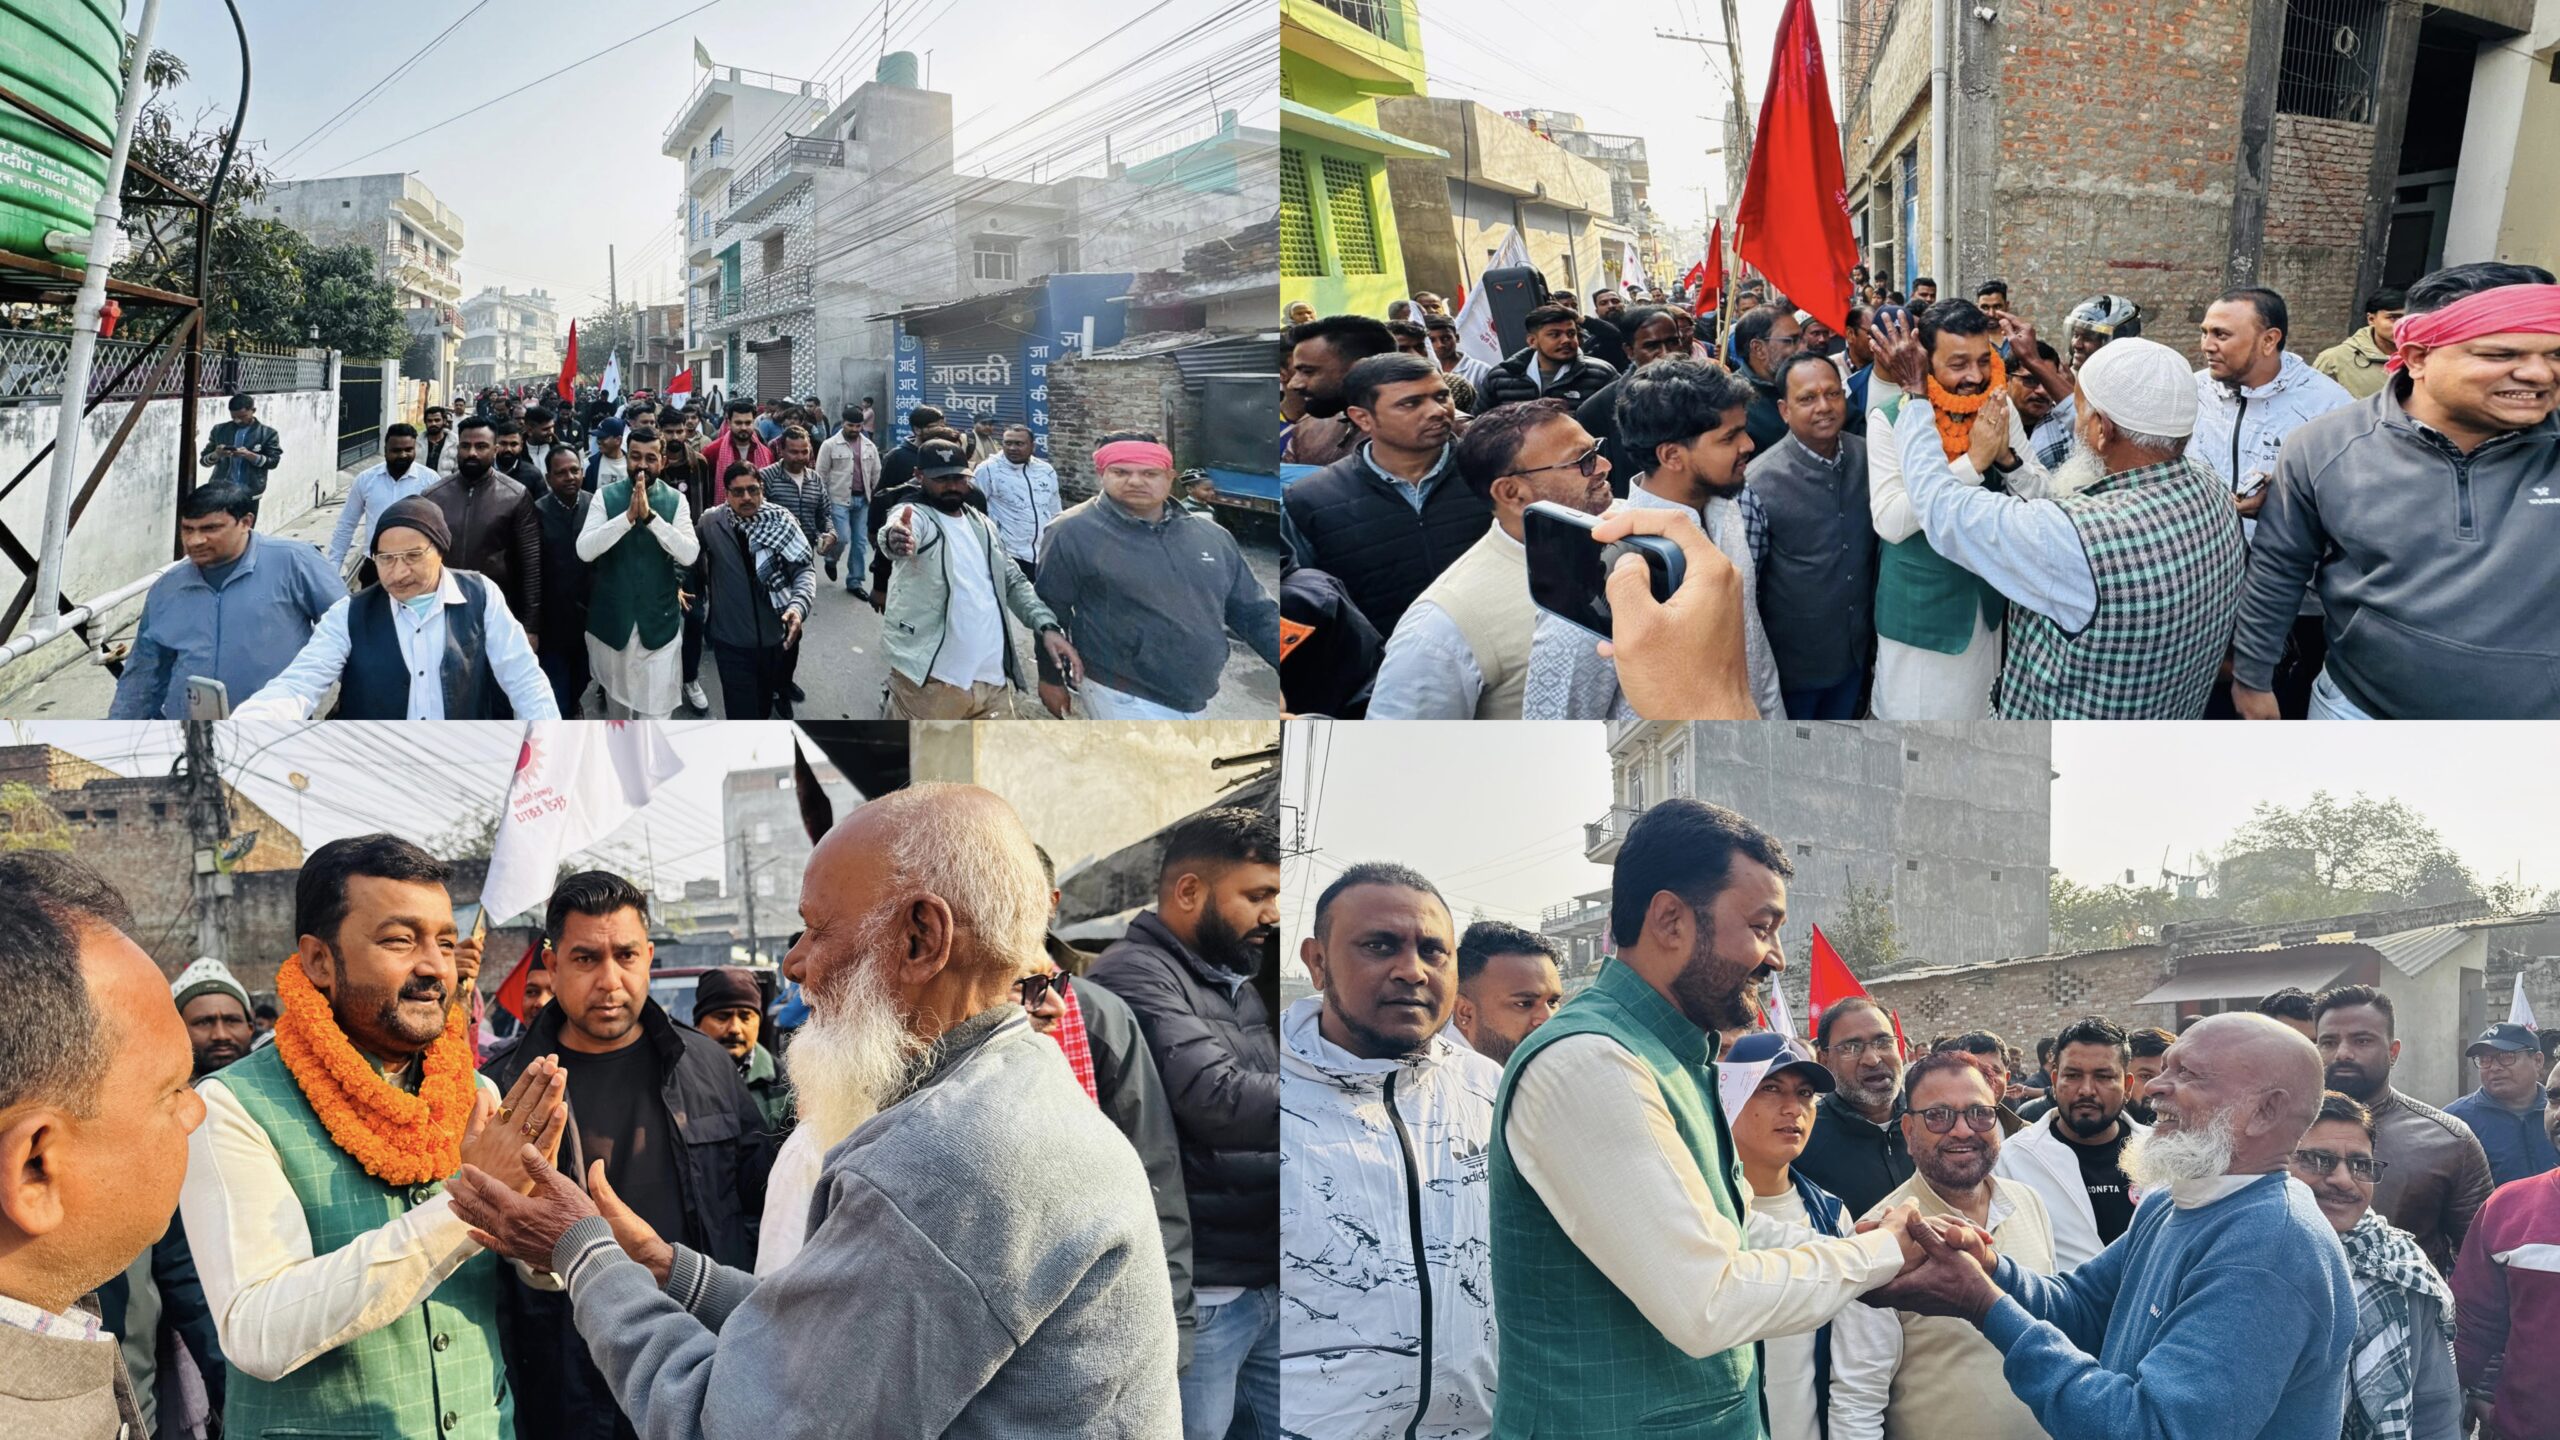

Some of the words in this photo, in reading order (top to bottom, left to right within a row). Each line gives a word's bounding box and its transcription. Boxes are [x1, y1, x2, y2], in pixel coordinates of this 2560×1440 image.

[0, 152, 33, 173] दीप
[37, 165, 69, 187] यादव
[898, 356, 917, 374] आई
[931, 354, 1012, 386] जानकी
[899, 379, 918, 391] आर
[945, 387, 999, 419] केबुल
[1461, 1168, 1488, 1186] adid
